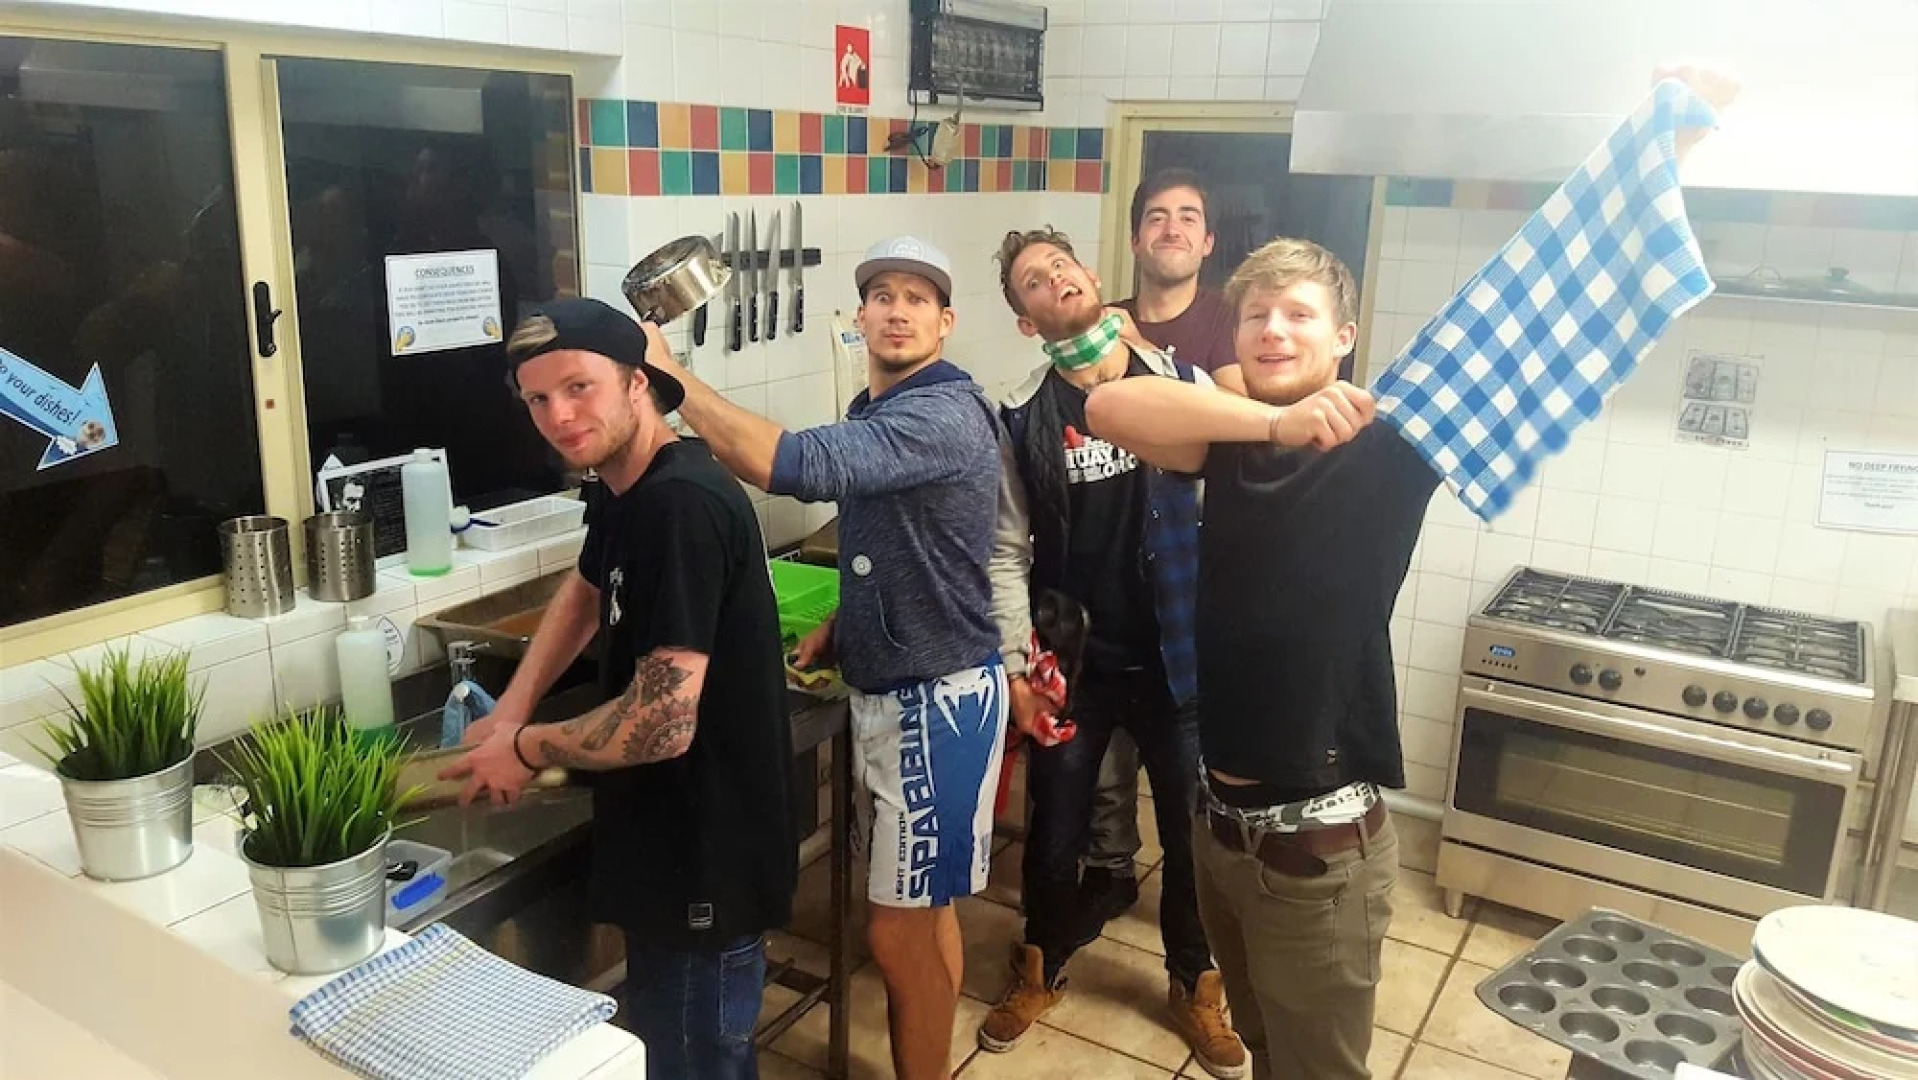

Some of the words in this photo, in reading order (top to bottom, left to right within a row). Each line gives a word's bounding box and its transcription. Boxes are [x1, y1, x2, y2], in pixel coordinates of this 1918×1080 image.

[415, 265, 475, 278] CONSEQUENCES
[6, 372, 36, 398] your
[34, 392, 83, 427] dishes!
[1848, 462, 1862, 471] NO
[1864, 462, 1888, 472] DEEP
[898, 811, 906, 861] EDITION
[896, 867, 905, 900] LIGHT
